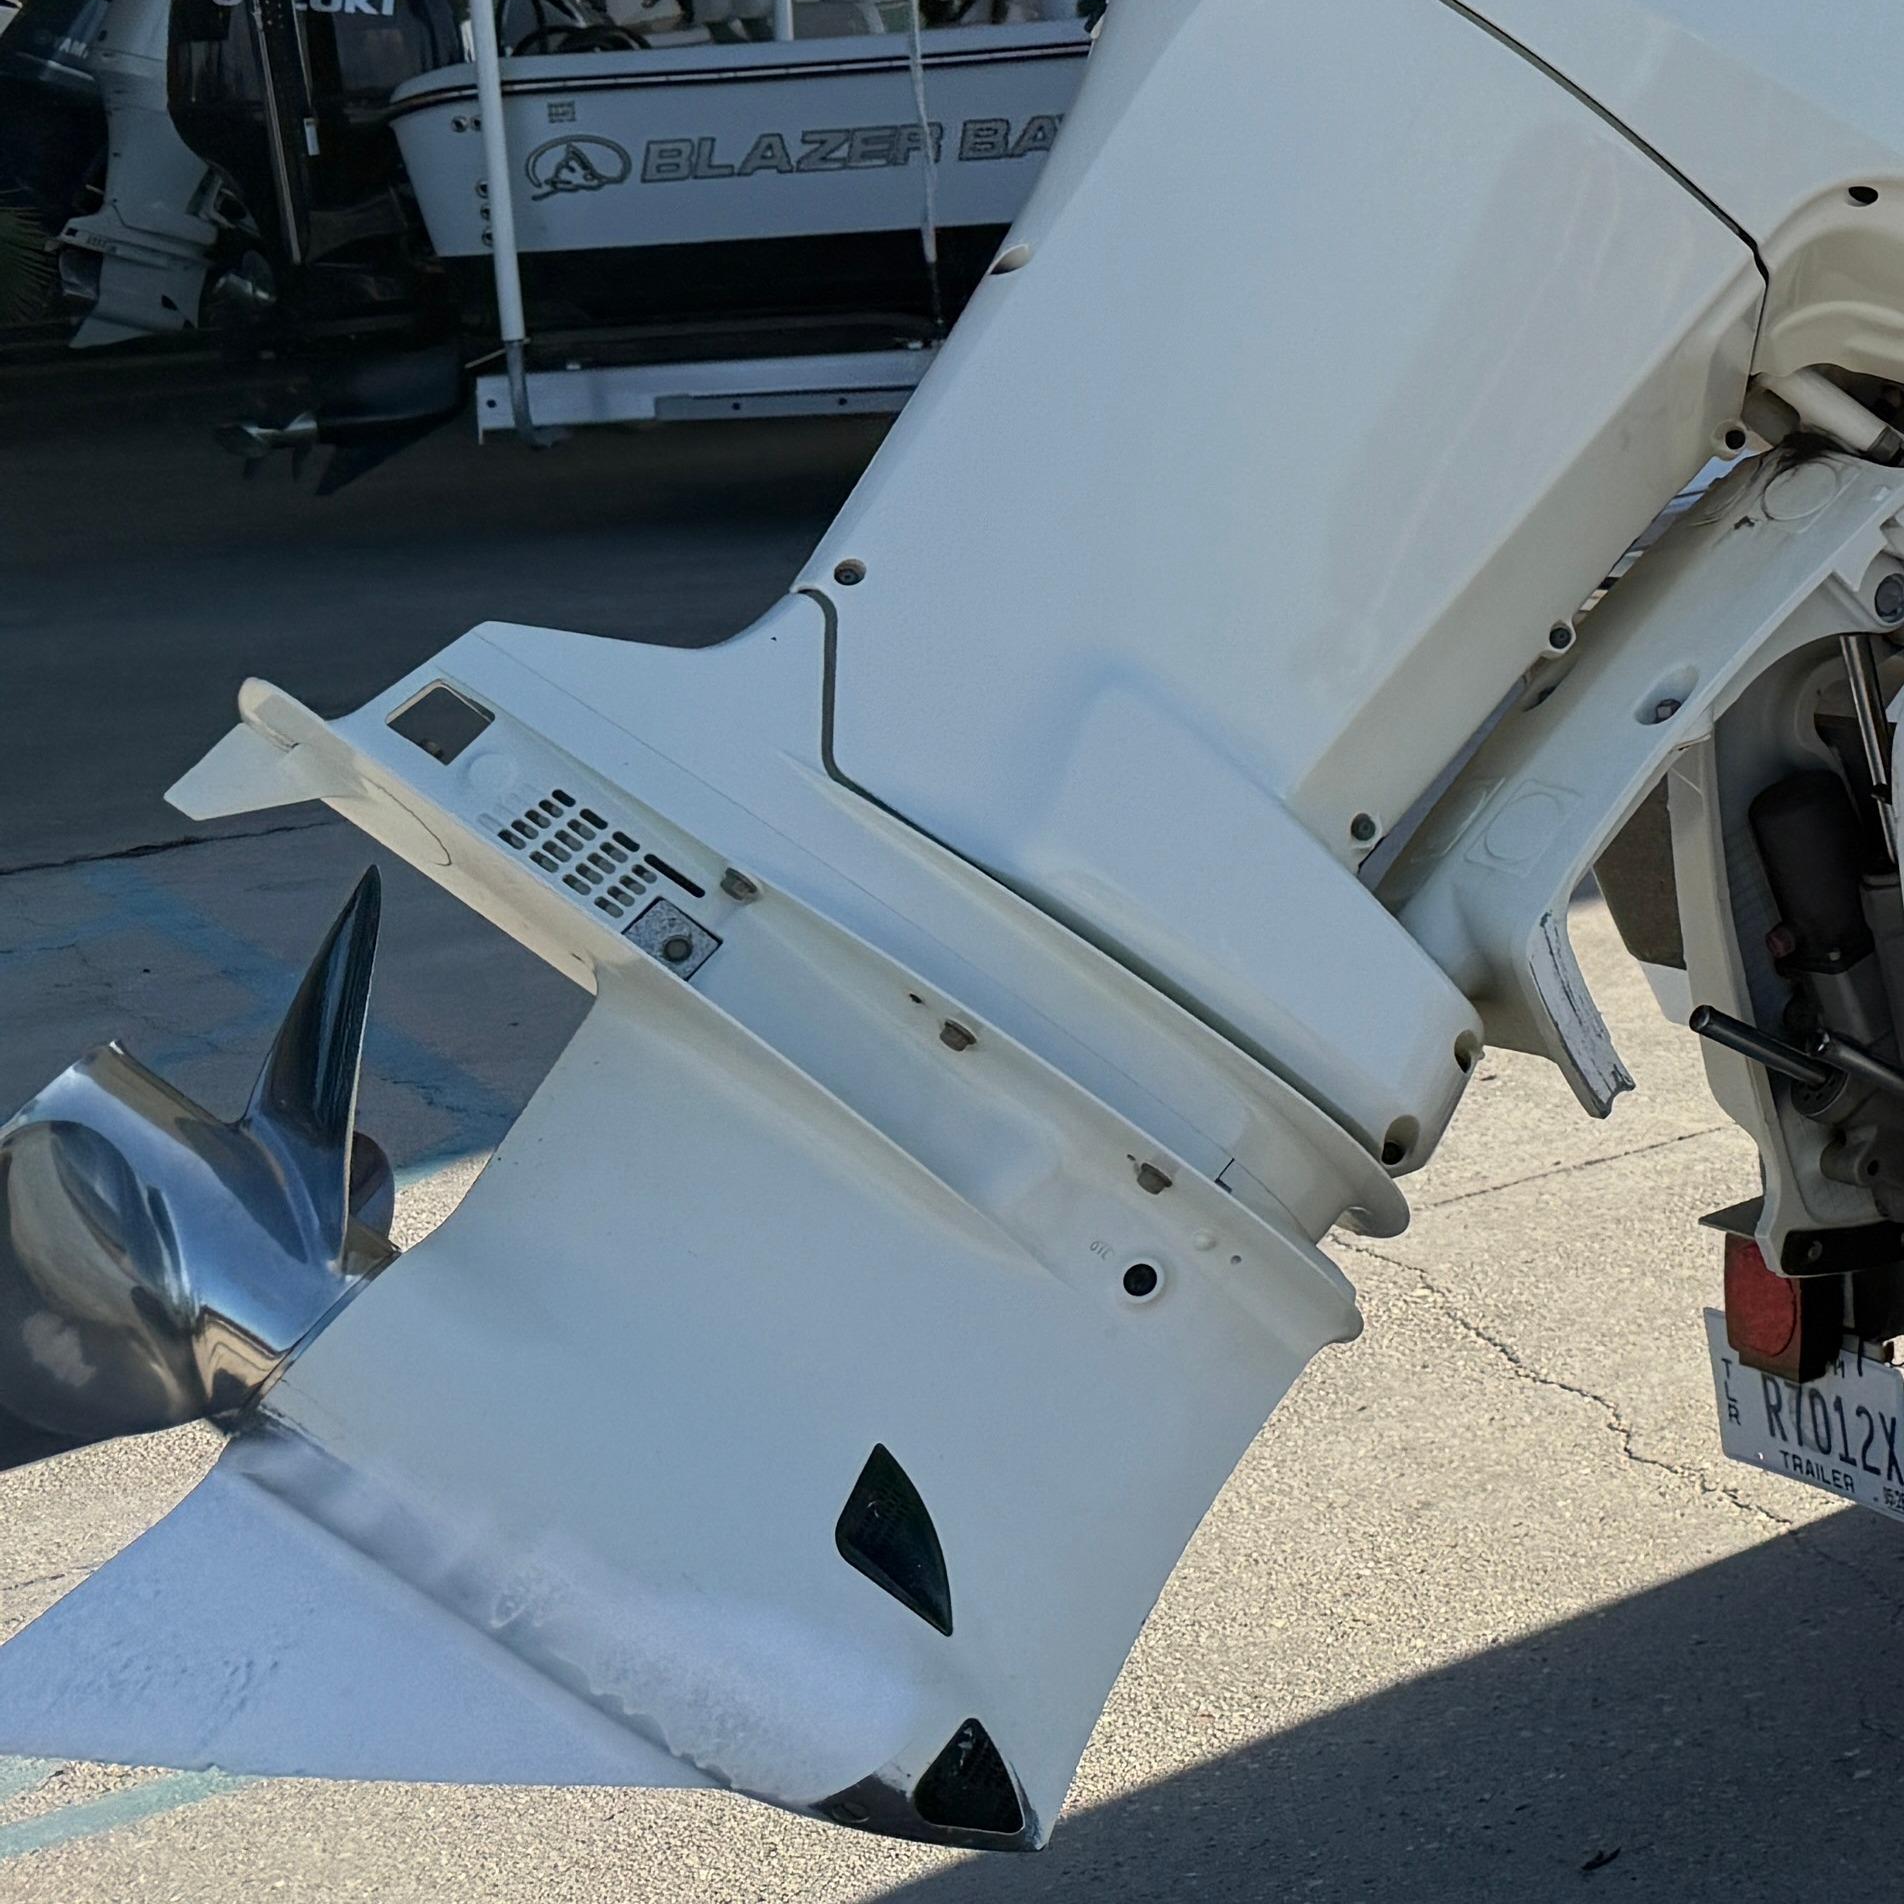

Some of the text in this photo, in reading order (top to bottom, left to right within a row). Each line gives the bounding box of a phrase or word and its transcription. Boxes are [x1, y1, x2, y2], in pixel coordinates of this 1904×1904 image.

[640, 121, 943, 184] BLAZER
[1760, 1373, 1904, 1487] R7012X
[1779, 1448, 1856, 1493] TRAILER
